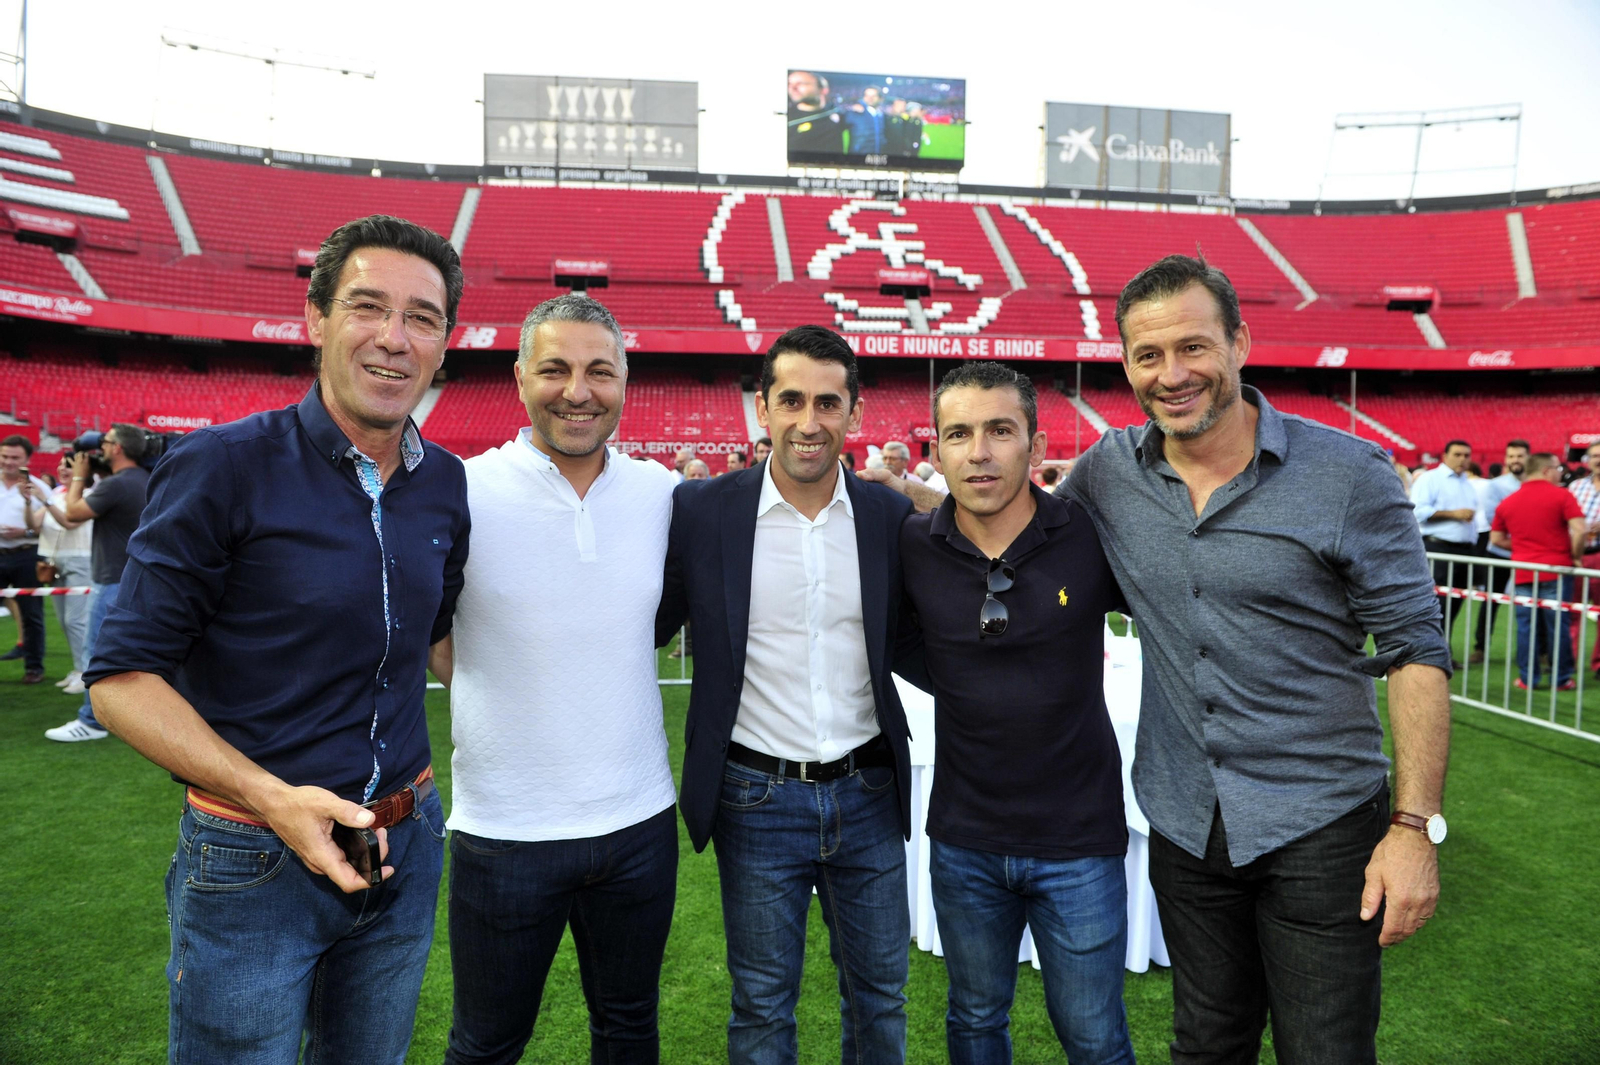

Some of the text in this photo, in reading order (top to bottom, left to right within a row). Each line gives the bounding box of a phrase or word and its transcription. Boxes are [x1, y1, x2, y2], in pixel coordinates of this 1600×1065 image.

[1105, 133, 1222, 167] CaixaBank
[504, 166, 649, 182] La Giralda presume orgullosa
[836, 178, 866, 190] Sevilla
[864, 336, 900, 355] QUE
[903, 336, 964, 356] NUNCA
[967, 338, 990, 357] SE
[994, 339, 1046, 358] RINDE
[147, 414, 213, 428] CORDIALITY
